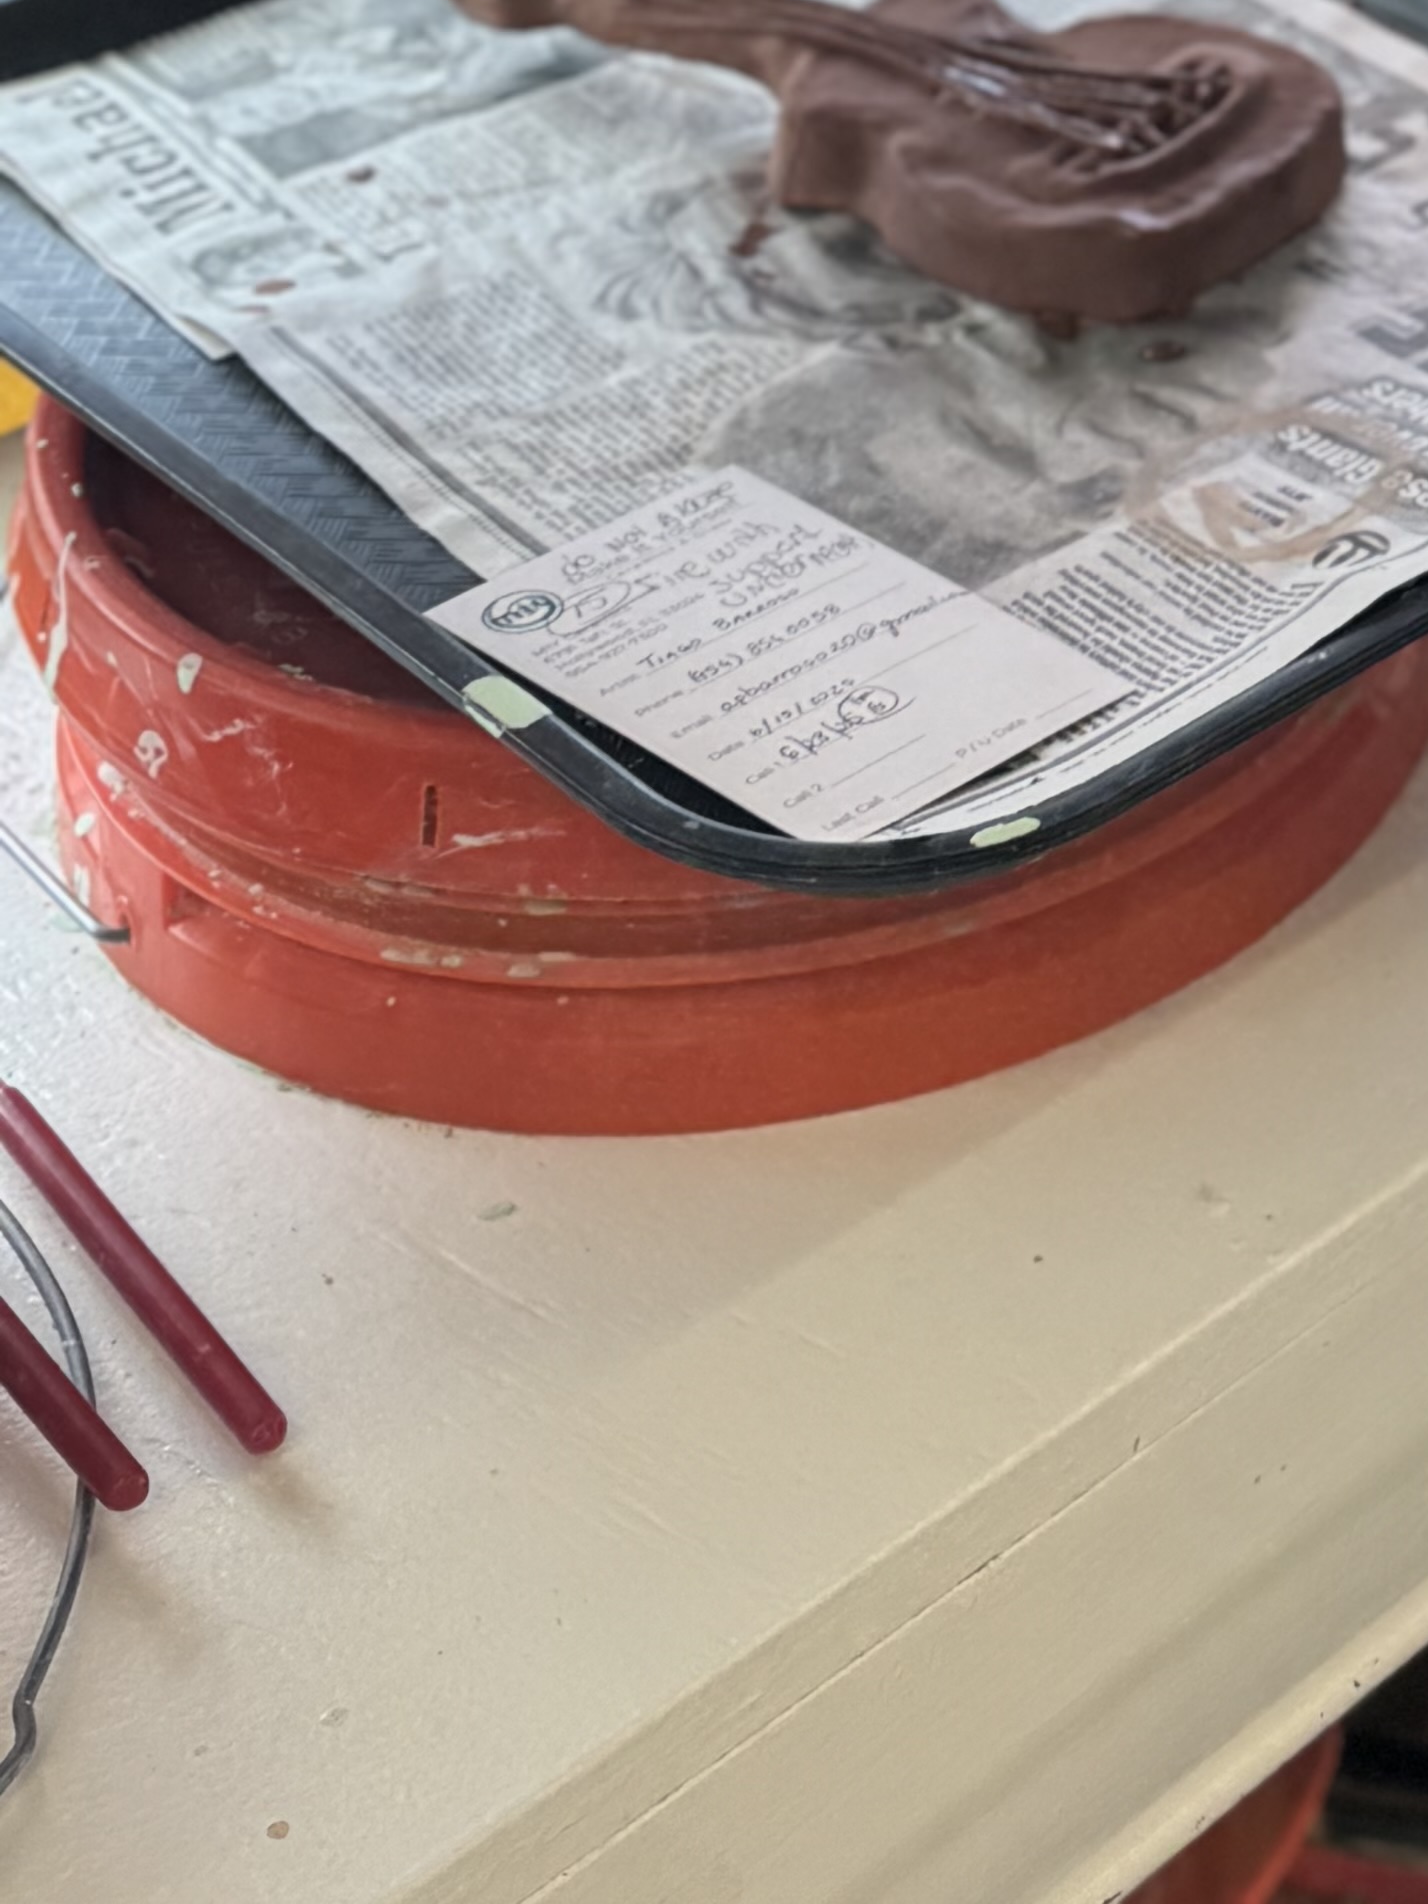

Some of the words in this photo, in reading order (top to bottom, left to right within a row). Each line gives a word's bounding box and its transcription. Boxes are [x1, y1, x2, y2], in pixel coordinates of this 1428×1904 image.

[1277, 424, 1383, 483] Giants
[669, 713, 715, 739] Email
[707, 740, 745, 762] Date
